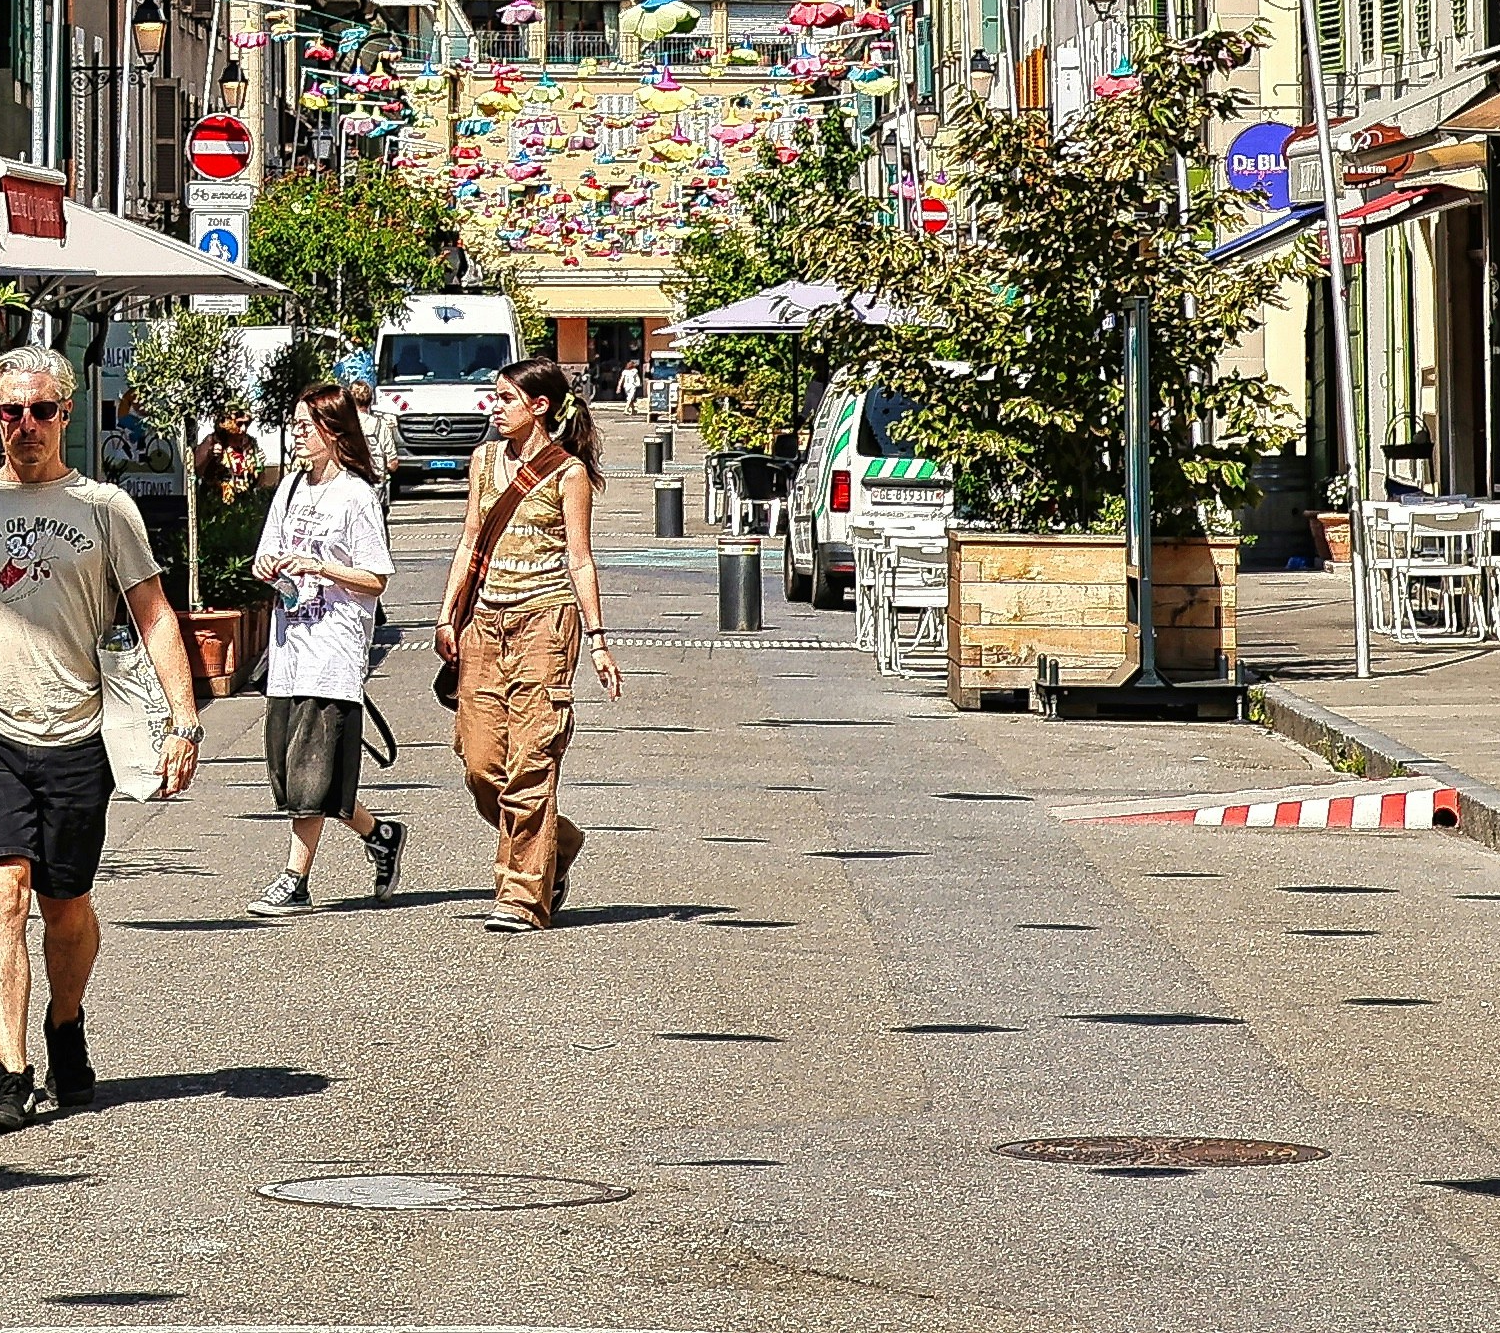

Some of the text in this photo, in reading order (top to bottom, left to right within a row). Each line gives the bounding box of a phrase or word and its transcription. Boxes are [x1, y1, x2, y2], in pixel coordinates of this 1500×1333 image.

[210, 191, 248, 201] autorisés
[208, 217, 232, 227] ZONE
[6, 517, 27, 535] OR
[32, 516, 96, 555] MOUSE?
